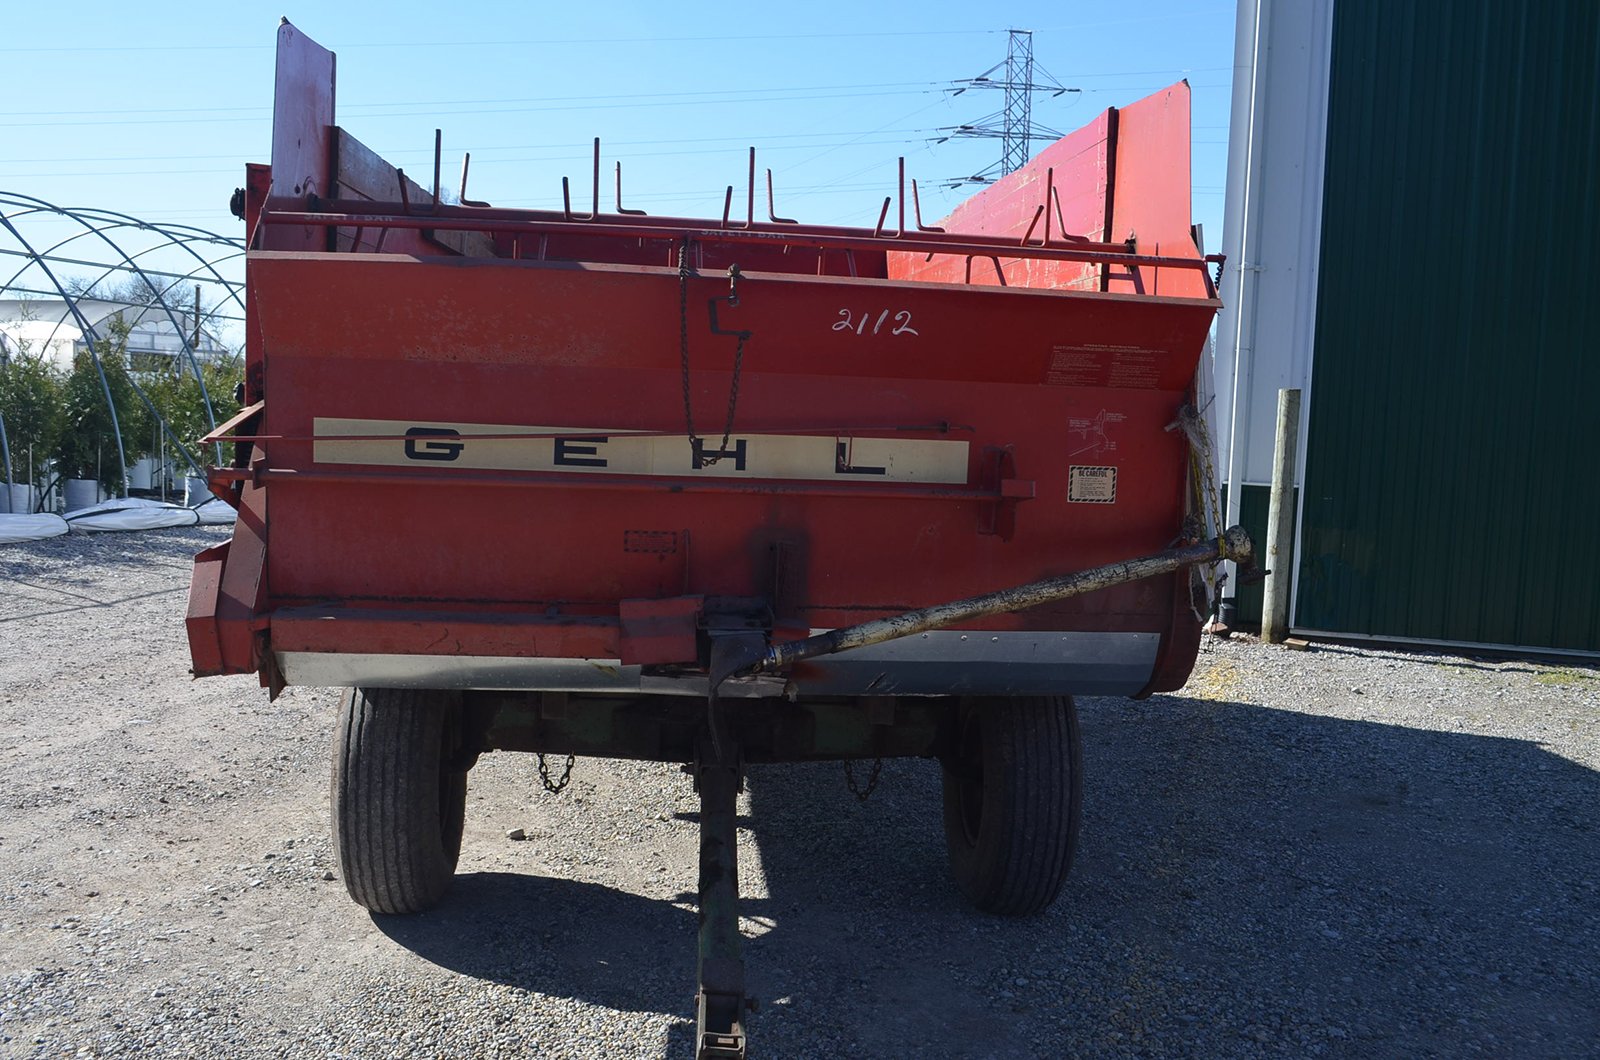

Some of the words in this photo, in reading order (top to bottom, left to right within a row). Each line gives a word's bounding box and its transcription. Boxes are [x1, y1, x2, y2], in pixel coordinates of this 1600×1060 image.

[831, 308, 919, 336] 2112
[404, 426, 887, 476] GEHL
[1085, 470, 1107, 478] CAREFUL
